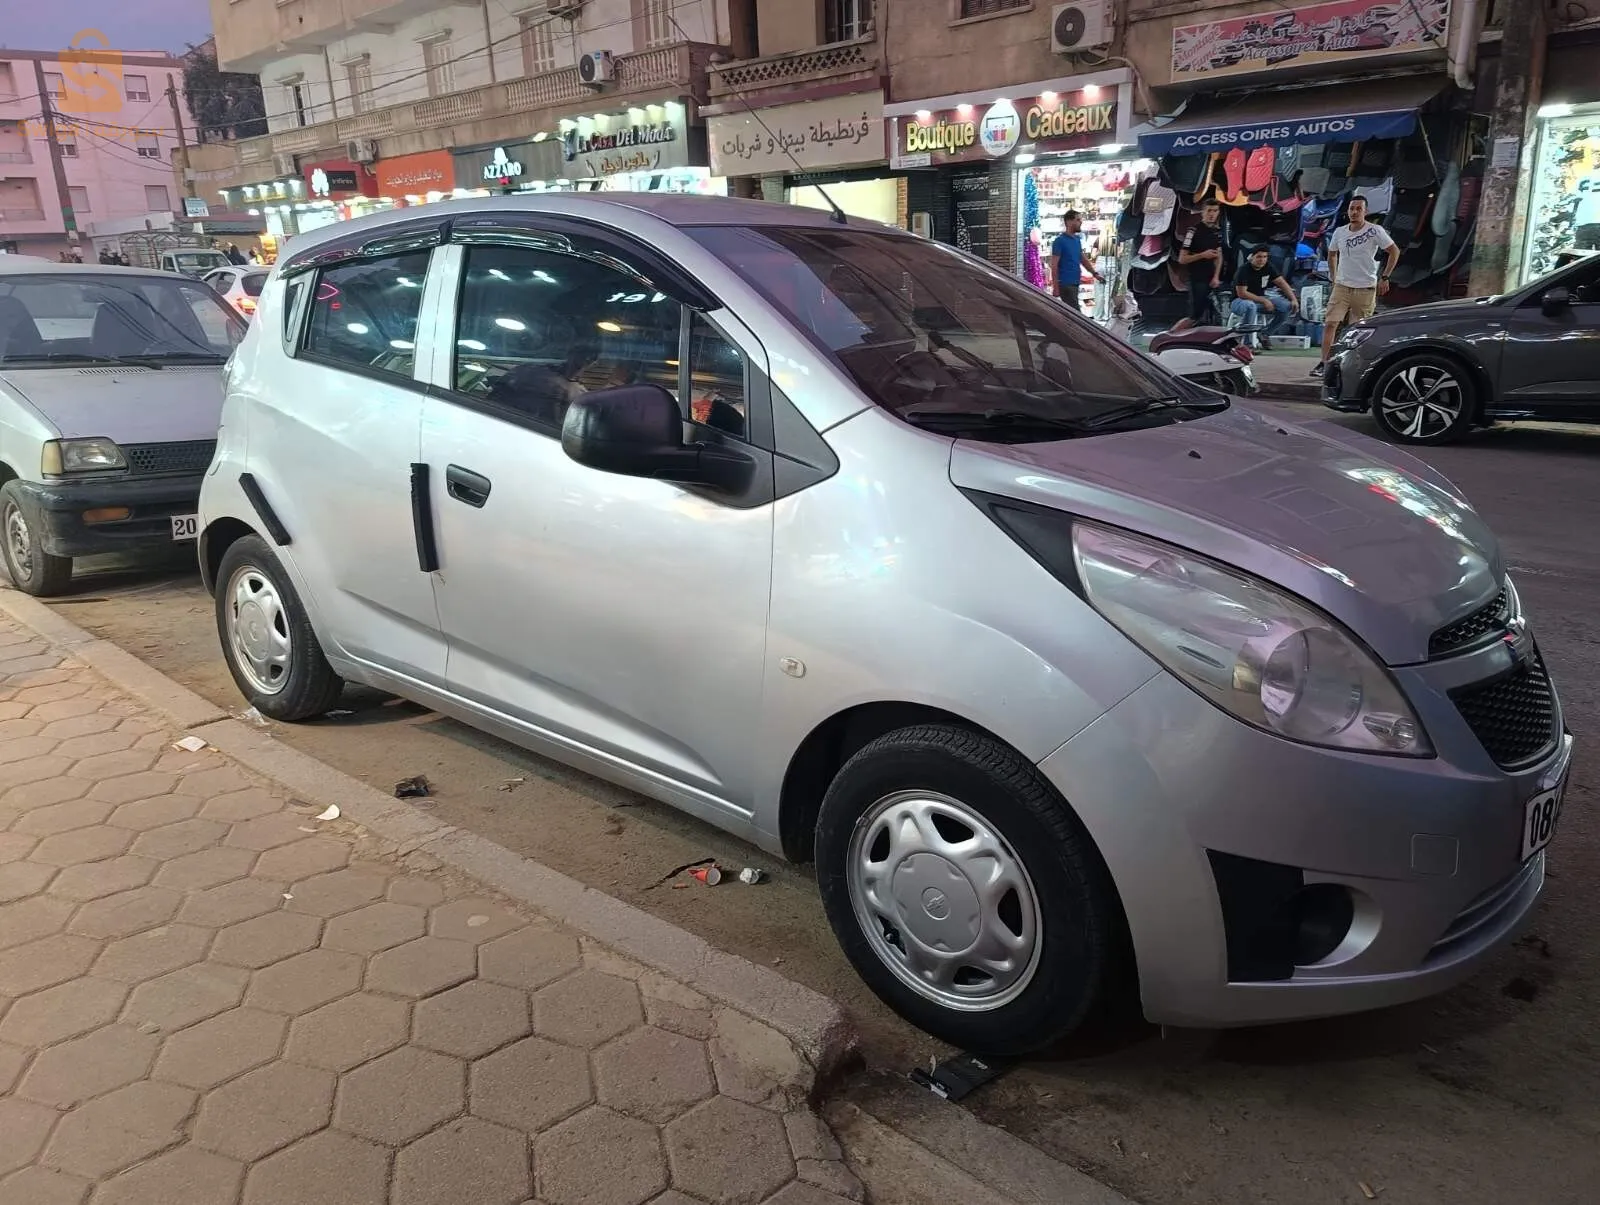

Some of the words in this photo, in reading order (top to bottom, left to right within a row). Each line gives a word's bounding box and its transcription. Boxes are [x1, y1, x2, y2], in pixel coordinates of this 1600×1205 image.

[1242, 39, 1317, 62] Accessoires
[1322, 35, 1360, 51] Auto
[906, 120, 976, 154] Boutique
[1025, 103, 1113, 139] Cadeaux
[1294, 118, 1356, 137] AUTOS
[722, 133, 762, 159] شربات
[483, 161, 522, 180] AZZARO
[174, 518, 198, 536] 20
[1530, 797, 1555, 848] 08
